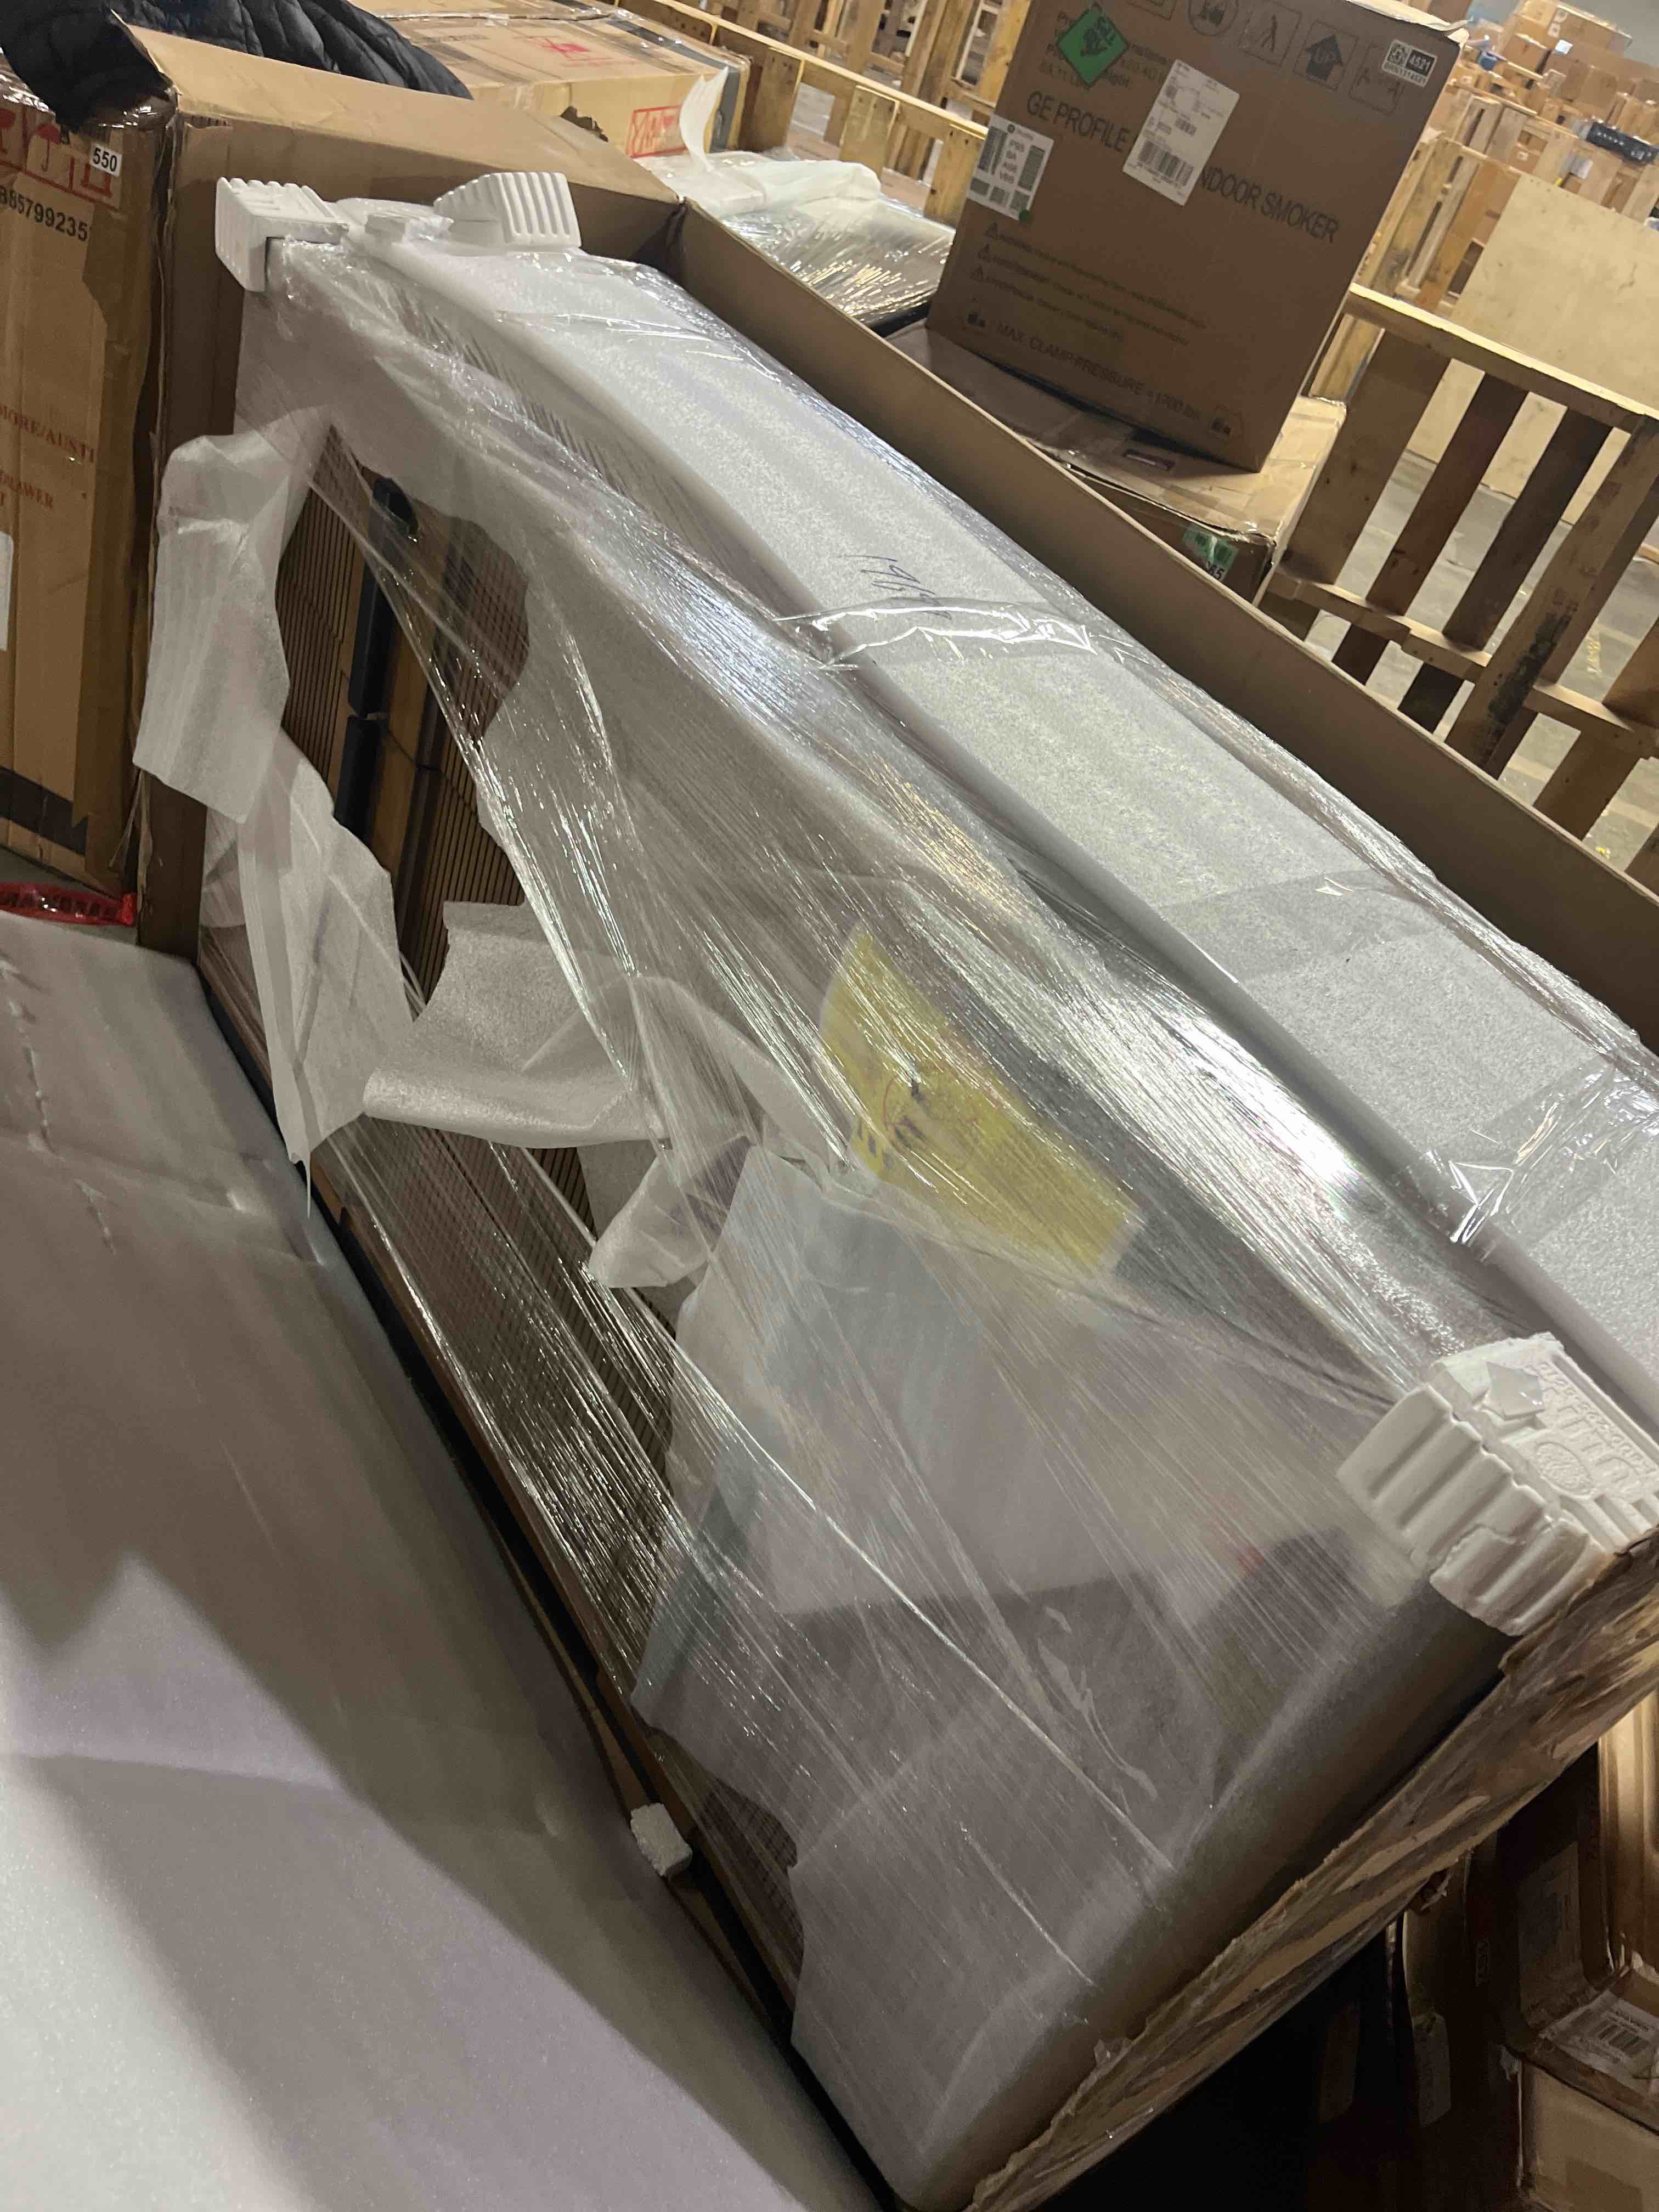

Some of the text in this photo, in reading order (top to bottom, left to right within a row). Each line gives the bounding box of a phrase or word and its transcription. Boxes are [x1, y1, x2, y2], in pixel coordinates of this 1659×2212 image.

[92, 147, 118, 172] 550
[1027, 91, 1055, 121] GE
[1053, 101, 1131, 153] PROFILE
[1201, 166, 1262, 210] NDOOR
[1261, 191, 1339, 244] SMOKER
